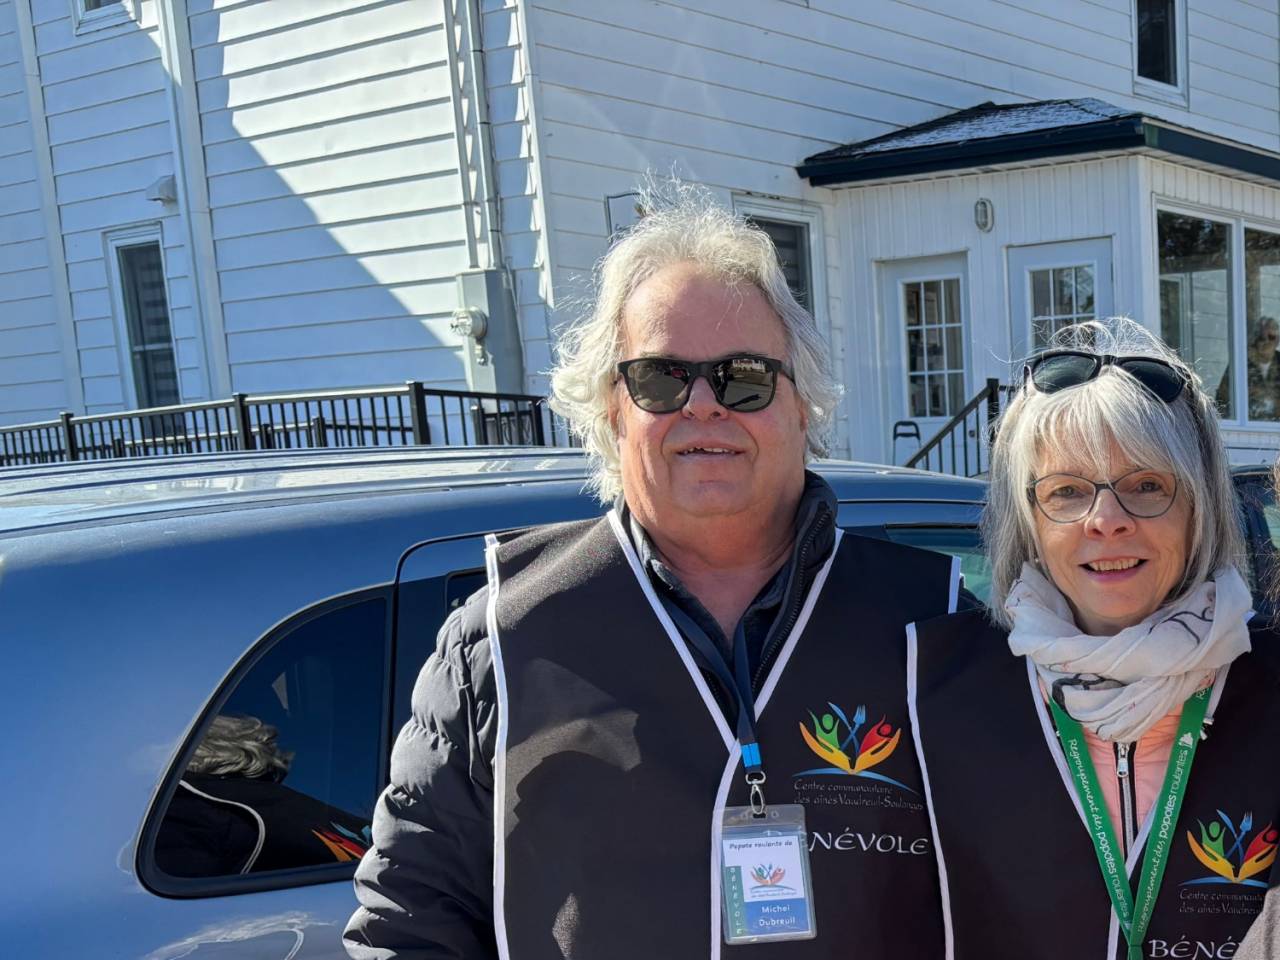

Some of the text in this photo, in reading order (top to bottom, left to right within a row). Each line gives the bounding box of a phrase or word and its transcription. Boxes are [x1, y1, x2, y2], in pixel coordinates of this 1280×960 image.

[794, 779, 825, 791] Centre
[1159, 794, 1177, 838] popotes
[1170, 749, 1188, 795] roulantes
[1067, 738, 1099, 814] Regroupement
[1096, 831, 1117, 875] popotes
[1111, 873, 1130, 918] roulantes
[806, 827, 929, 855] NÉVOLE
[1179, 888, 1209, 900] Centre
[761, 904, 790, 913] Michel
[1179, 901, 1195, 913] des
[1148, 935, 1241, 960] BÉNÉ
